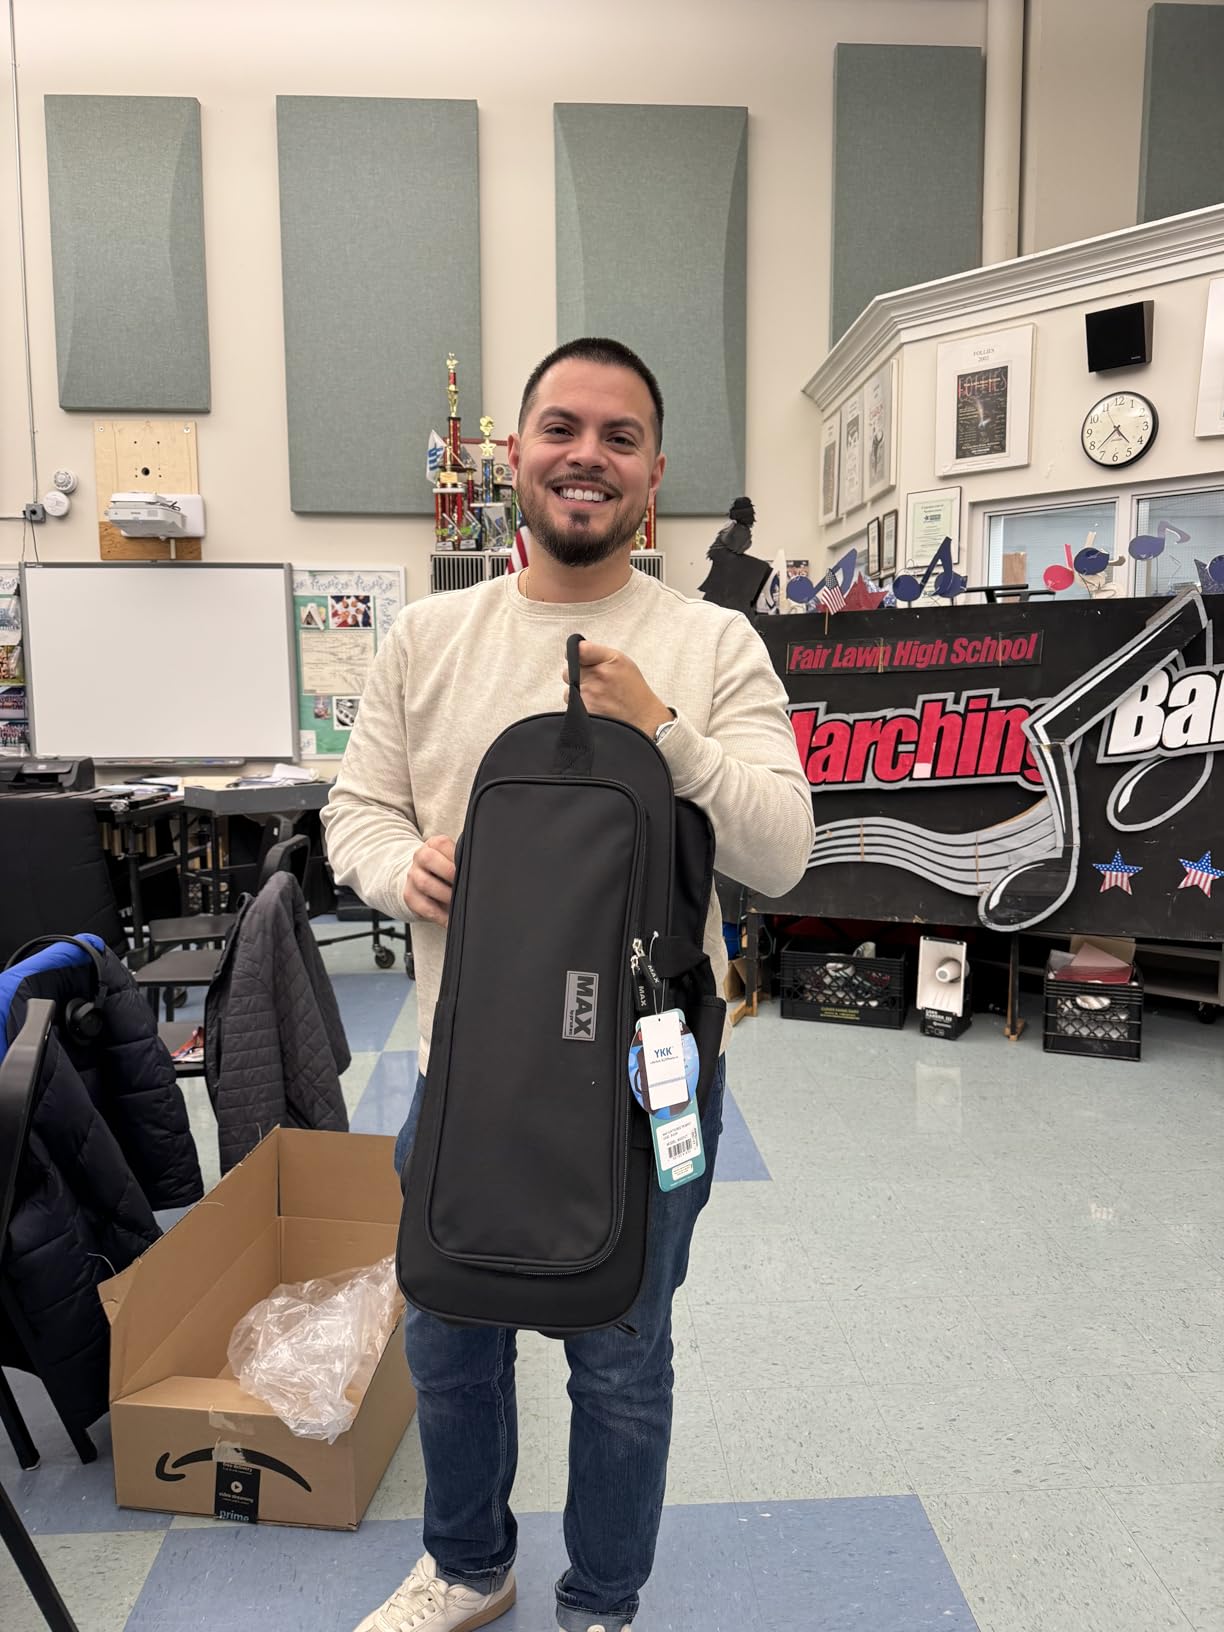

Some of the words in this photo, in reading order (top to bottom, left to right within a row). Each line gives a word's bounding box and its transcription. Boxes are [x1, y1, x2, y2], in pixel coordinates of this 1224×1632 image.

[1114, 396, 1125, 406] 12
[1130, 399, 1135, 409] 1
[1102, 403, 1110, 413] 11
[1138, 408, 1146, 418] 2
[1089, 414, 1099, 424] 10
[1142, 421, 1149, 431] 3
[1086, 428, 1093, 438] 9
[1137, 435, 1144, 445] 4
[1089, 441, 1096, 451] 8
[1099, 450, 1106, 460] 7
[1112, 452, 1118, 462] 6
[1125, 447, 1132, 457] 5
[789, 644, 832, 671] Fair
[832, 642, 892, 668] Lawn
[893, 639, 949, 668] High
[950, 632, 1039, 664] School
[648, 965, 660, 983] MAX
[638, 985, 647, 1007] MAX
[574, 975, 595, 1036] MAX
[654, 1046, 673, 1058] YKK
[220, 1510, 250, 1521] prime
